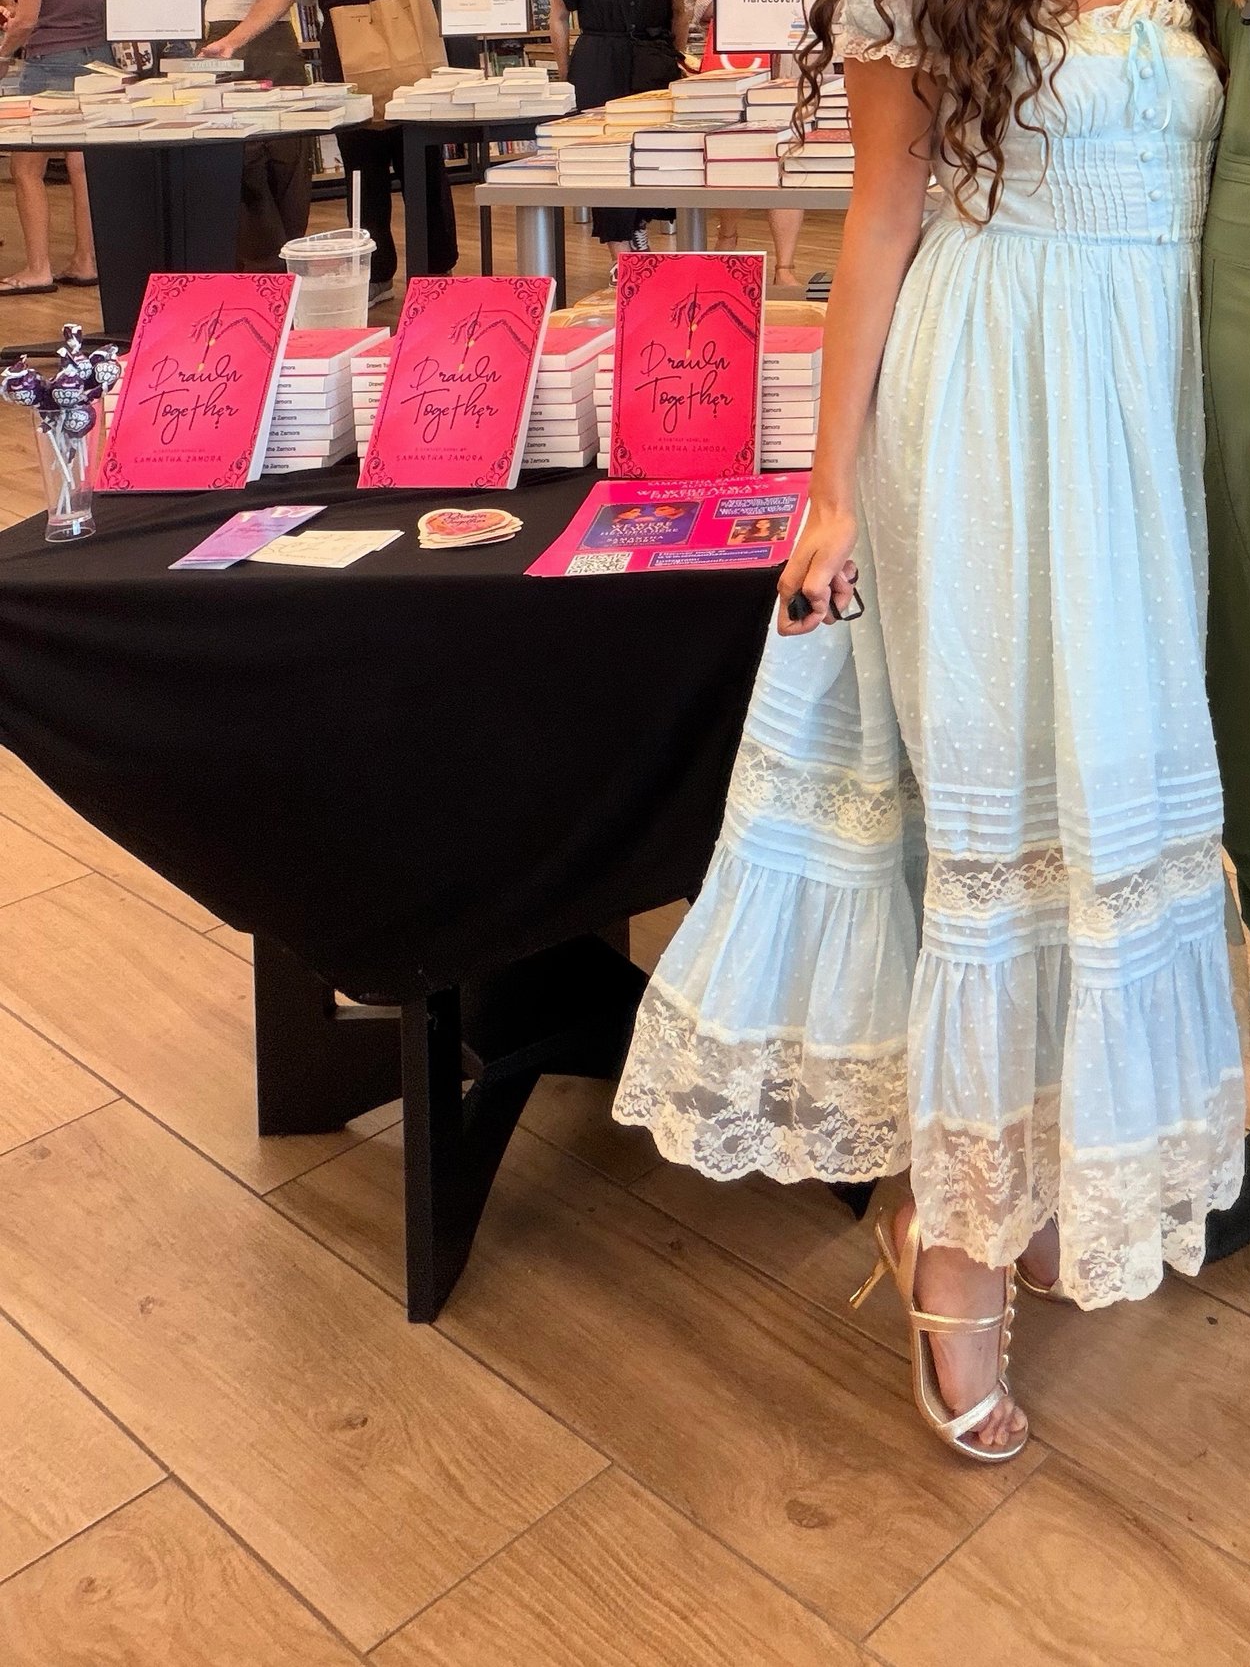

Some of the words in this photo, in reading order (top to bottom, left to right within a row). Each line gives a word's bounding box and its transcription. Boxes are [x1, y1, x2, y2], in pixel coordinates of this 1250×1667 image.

[148, 354, 242, 392] Drawn
[409, 354, 503, 391] Drawn
[638, 339, 732, 379] Drawn
[138, 381, 240, 446] Together
[400, 381, 500, 444] Together
[634, 368, 734, 435] Together
[762, 406, 782, 414] Zamora
